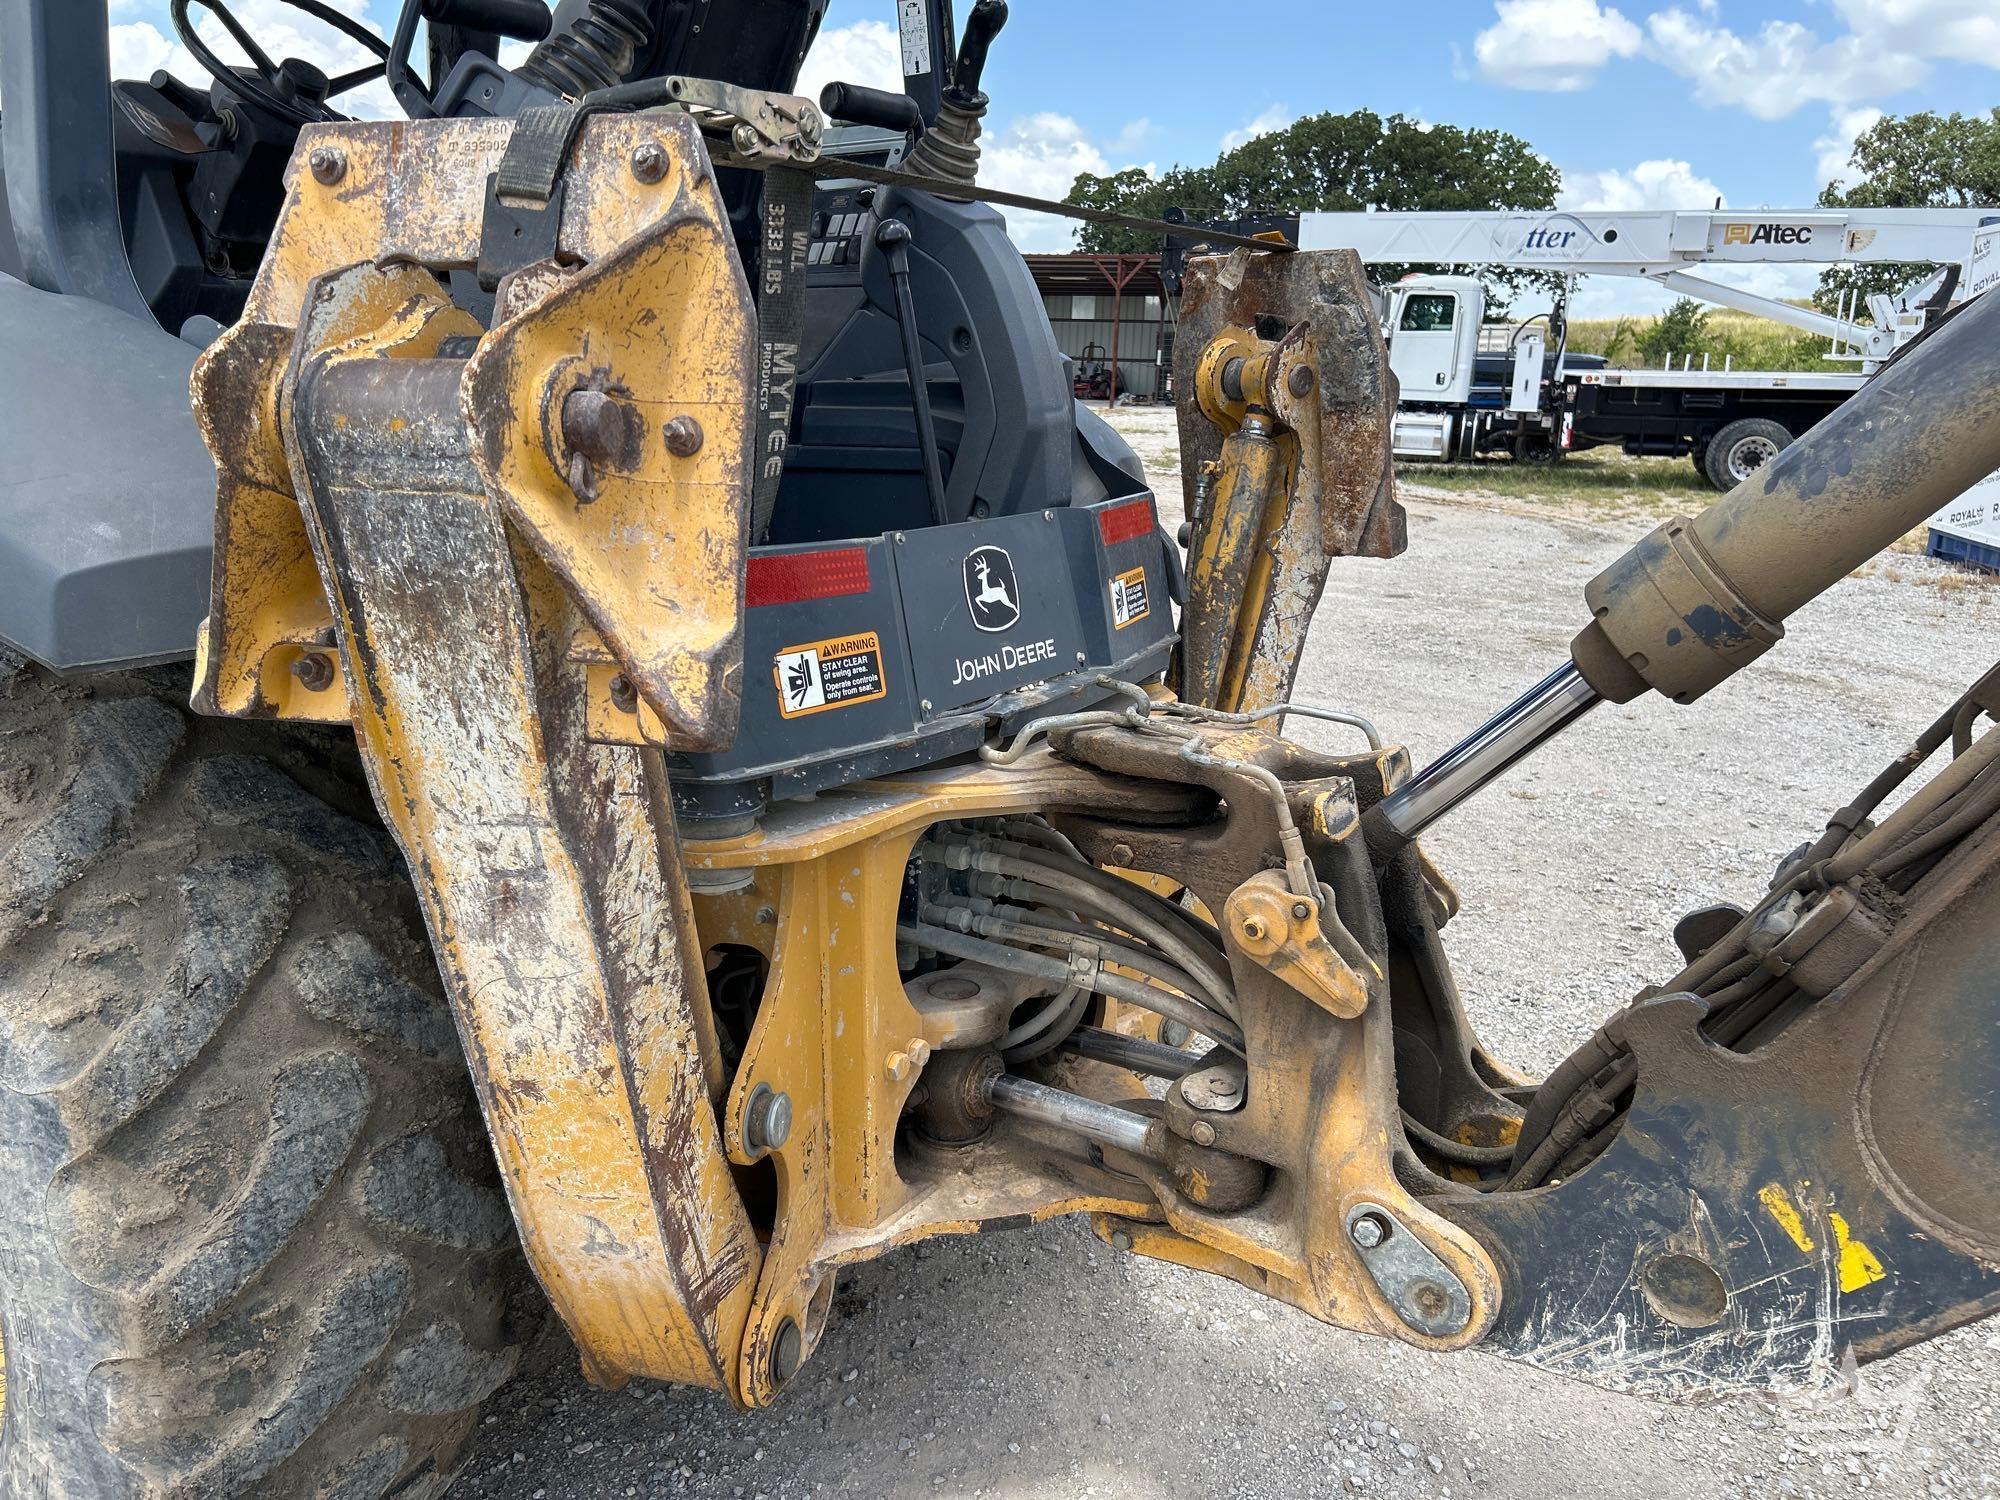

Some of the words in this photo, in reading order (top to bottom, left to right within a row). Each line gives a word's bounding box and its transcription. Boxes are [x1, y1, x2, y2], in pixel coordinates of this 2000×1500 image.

[1750, 224, 1812, 245] Altec
[790, 231, 808, 273] WLL
[765, 256, 783, 295] LBS
[1973, 271, 2000, 294] ROYAL
[760, 342, 773, 411] PRODUCTS
[763, 343, 799, 479] MYTEE
[1950, 509, 1977, 523] ROYAL
[830, 637, 876, 655] WARNING
[822, 660, 842, 672] STAY
[843, 655, 868, 667] CLEAR
[952, 653, 1001, 685] JOHN
[1001, 638, 1057, 670] DEERE
[823, 671, 831, 680] of
[832, 668, 851, 679] swing
[852, 665, 869, 675] area.
[825, 680, 852, 692] Operate
[852, 674, 878, 685] controls
[827, 689, 841, 700] only
[842, 686, 858, 696] from
[858, 683, 874, 693] seat.
